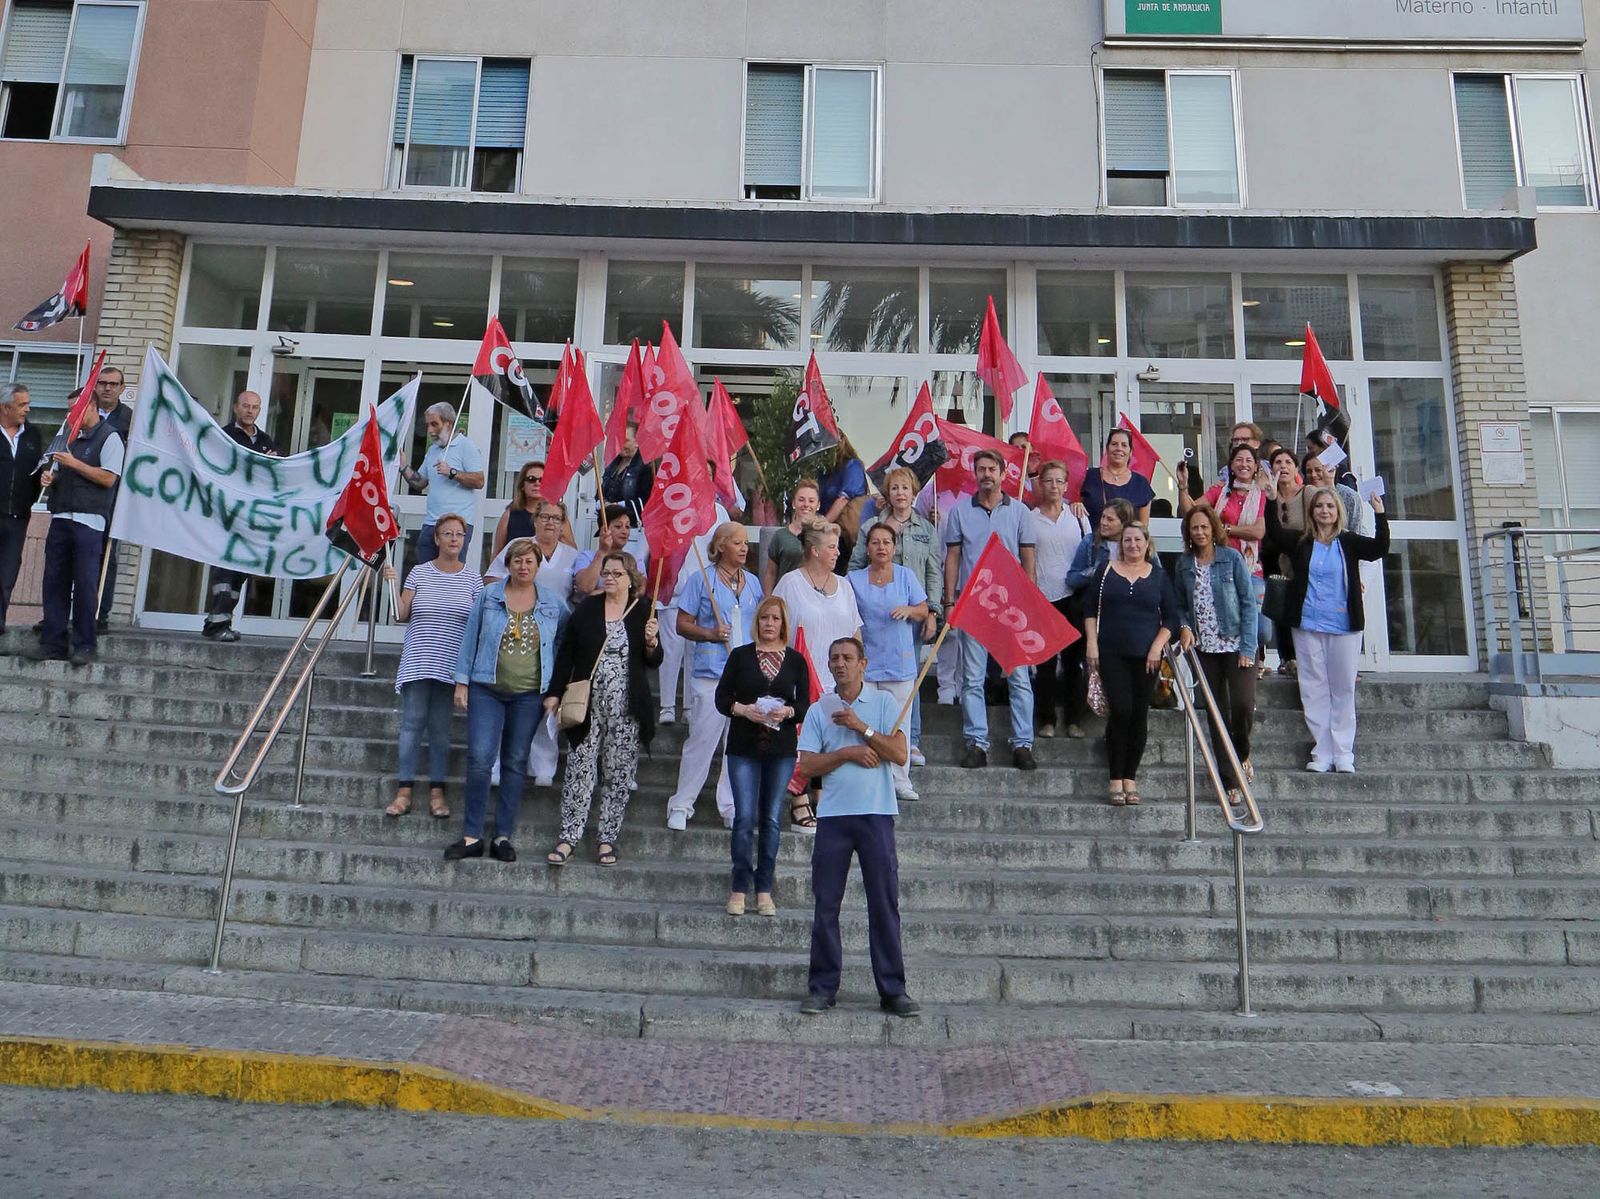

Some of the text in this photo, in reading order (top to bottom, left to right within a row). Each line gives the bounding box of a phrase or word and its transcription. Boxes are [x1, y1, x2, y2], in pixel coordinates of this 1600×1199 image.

[1137, 3, 1159, 12] JUNTA
[1162, 3, 1171, 12] DE
[490, 346, 533, 399] CG
[147, 372, 290, 493] POR
[792, 391, 820, 439] GT
[125, 454, 323, 536] CONVÉN
[220, 531, 358, 577] DIGN
